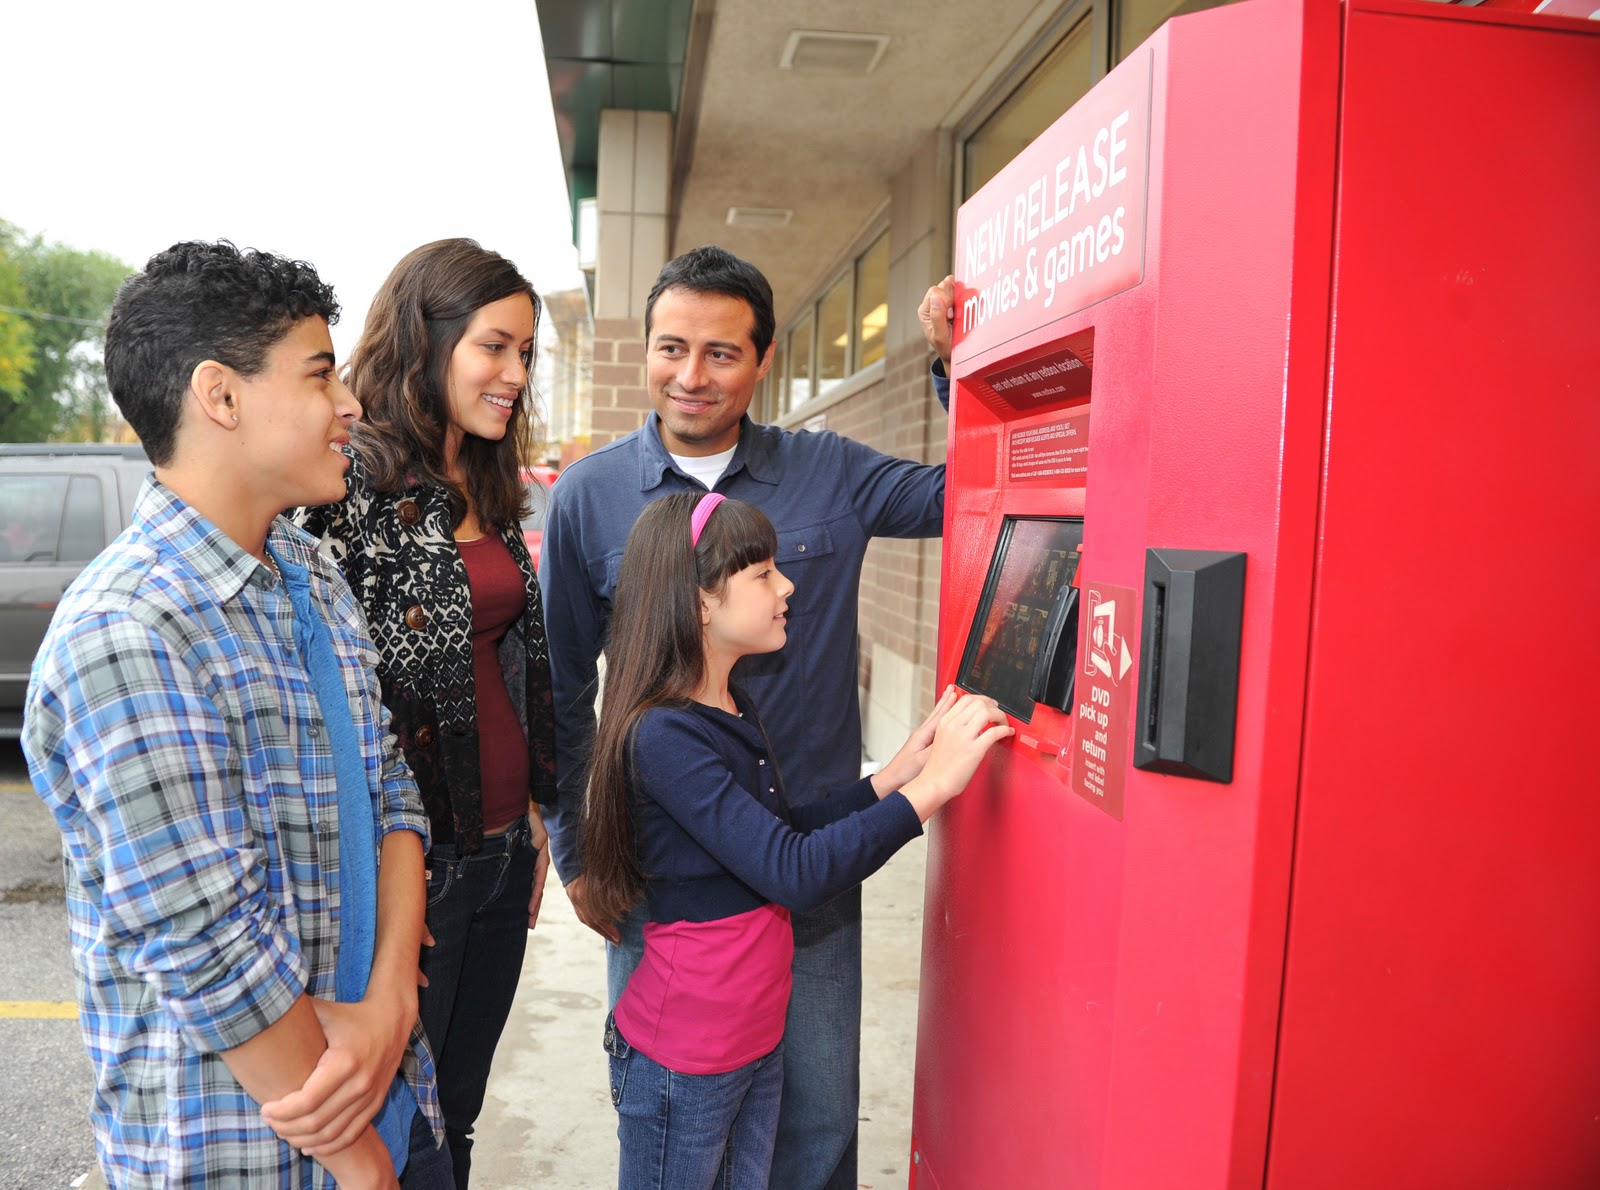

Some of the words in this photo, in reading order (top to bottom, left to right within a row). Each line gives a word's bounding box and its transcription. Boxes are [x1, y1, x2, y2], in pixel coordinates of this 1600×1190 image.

[965, 203, 1009, 283] NEW
[1013, 110, 1129, 251] RELEASE
[963, 268, 1020, 333] movies
[1024, 247, 1038, 300] &
[1044, 206, 1125, 308] games
[1000, 378, 1013, 389] and
[1009, 376, 1028, 386] return
[1023, 372, 1033, 382] at
[1028, 371, 1044, 381] any
[1039, 365, 1060, 378] redbox
[1053, 358, 1084, 372] location
[1031, 385, 1066, 398] www.redbox.com
[1091, 685, 1110, 707] DVD
[1079, 702, 1096, 720] pick
[1097, 712, 1109, 730] up
[1095, 730, 1107, 745] and
[1082, 739, 1106, 762] return
[1085, 758, 1097, 772] insert
[1096, 764, 1105, 776] with
[1084, 778, 1096, 793] facing
[1095, 786, 1104, 797] you
